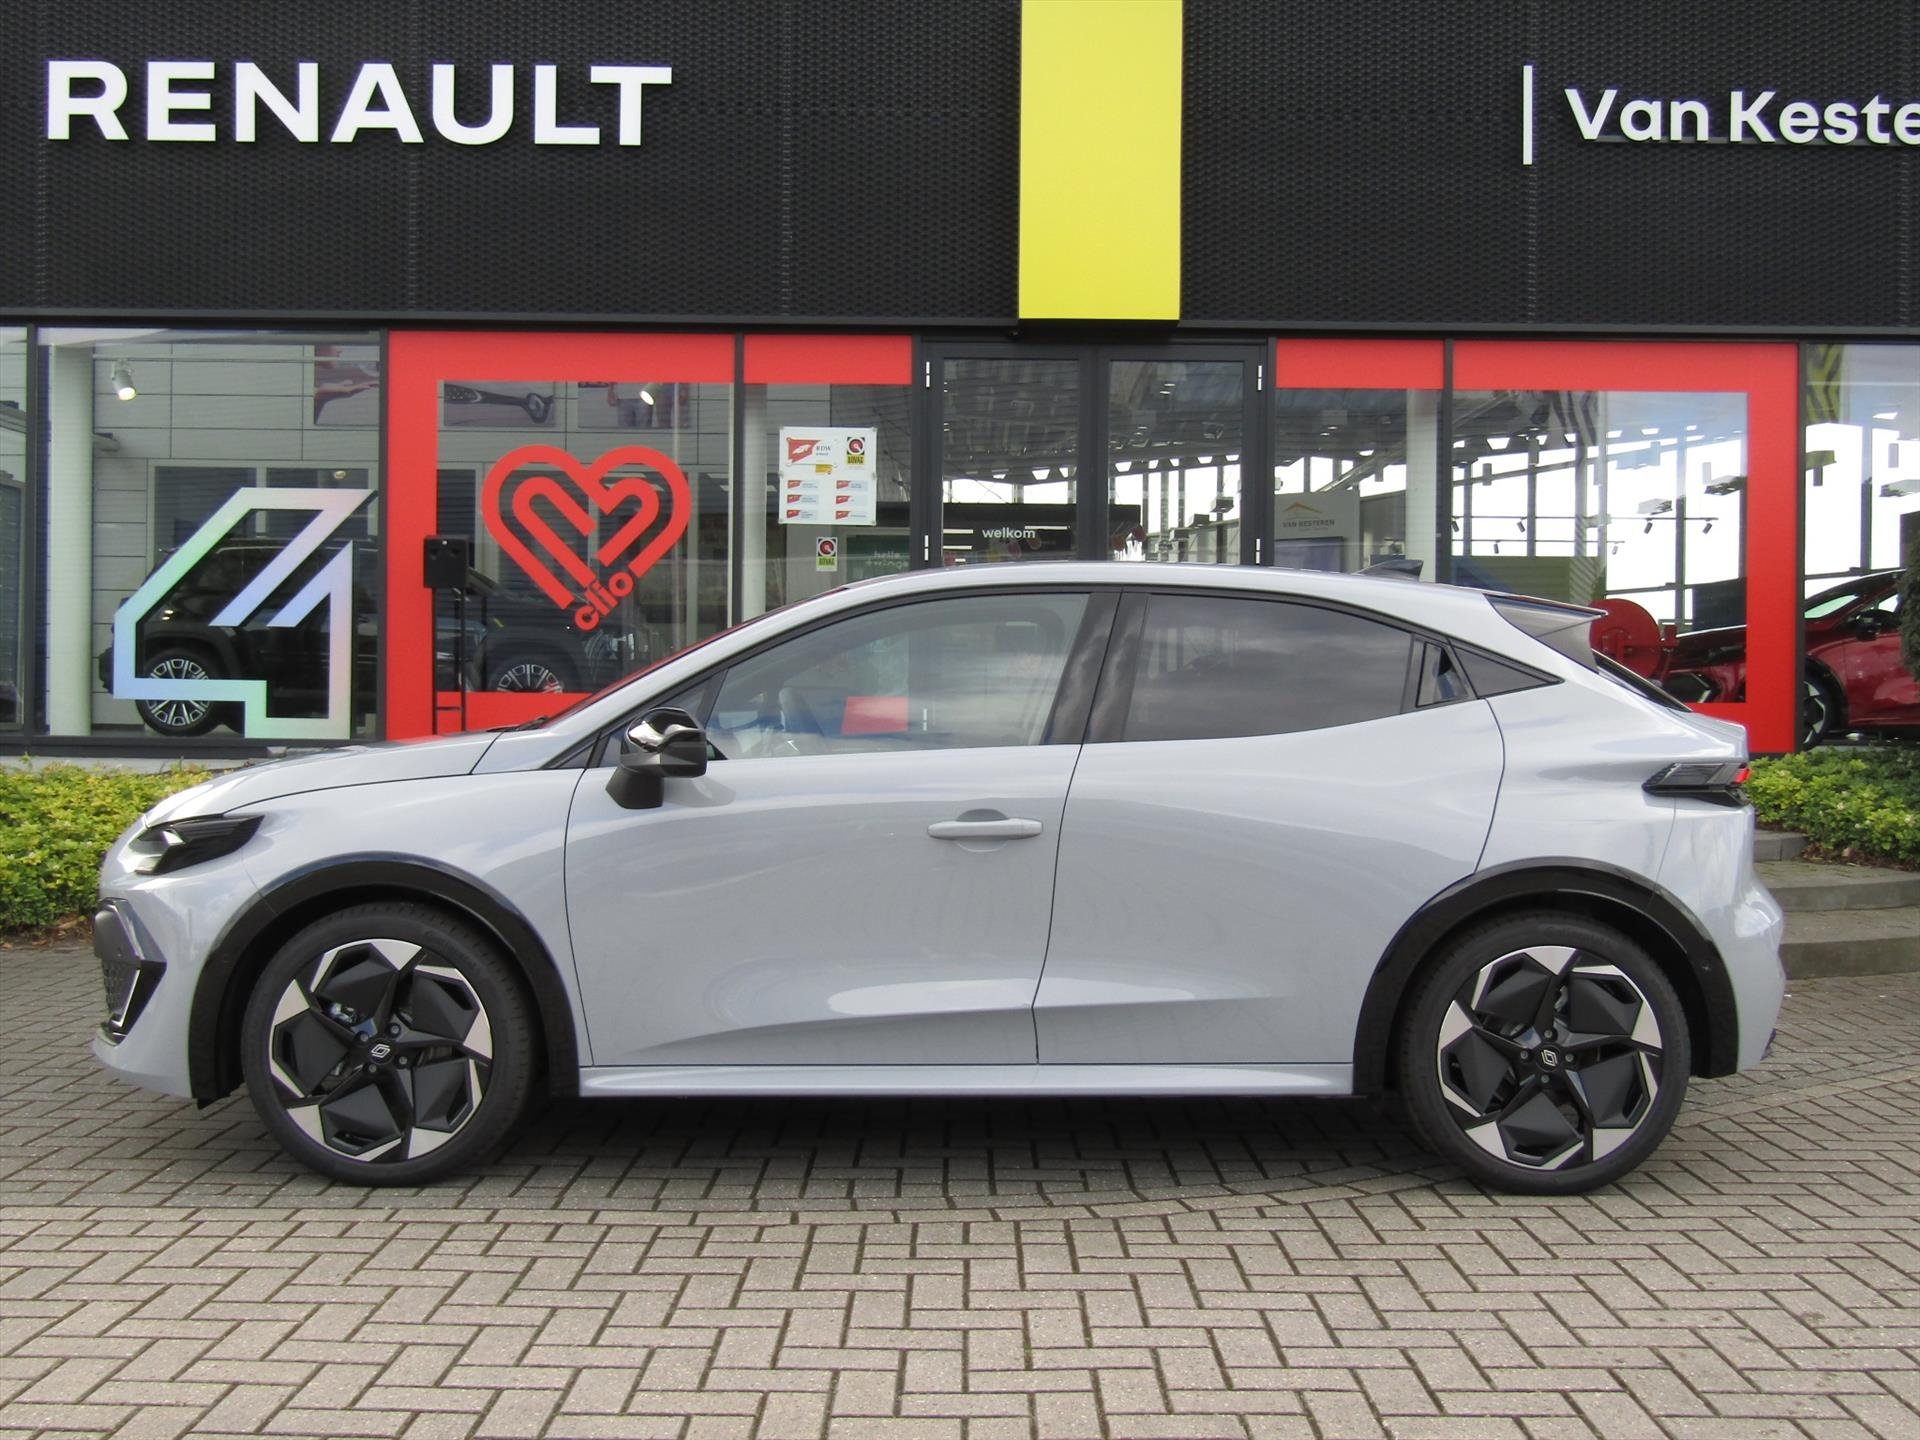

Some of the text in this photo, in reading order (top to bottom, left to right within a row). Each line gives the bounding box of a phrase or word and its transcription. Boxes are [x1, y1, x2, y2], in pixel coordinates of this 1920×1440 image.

[46, 60, 673, 147] RENAULT
[1565, 88, 1920, 146] Van Keste
[981, 526, 1037, 540] welkom
[574, 571, 635, 632] clio
